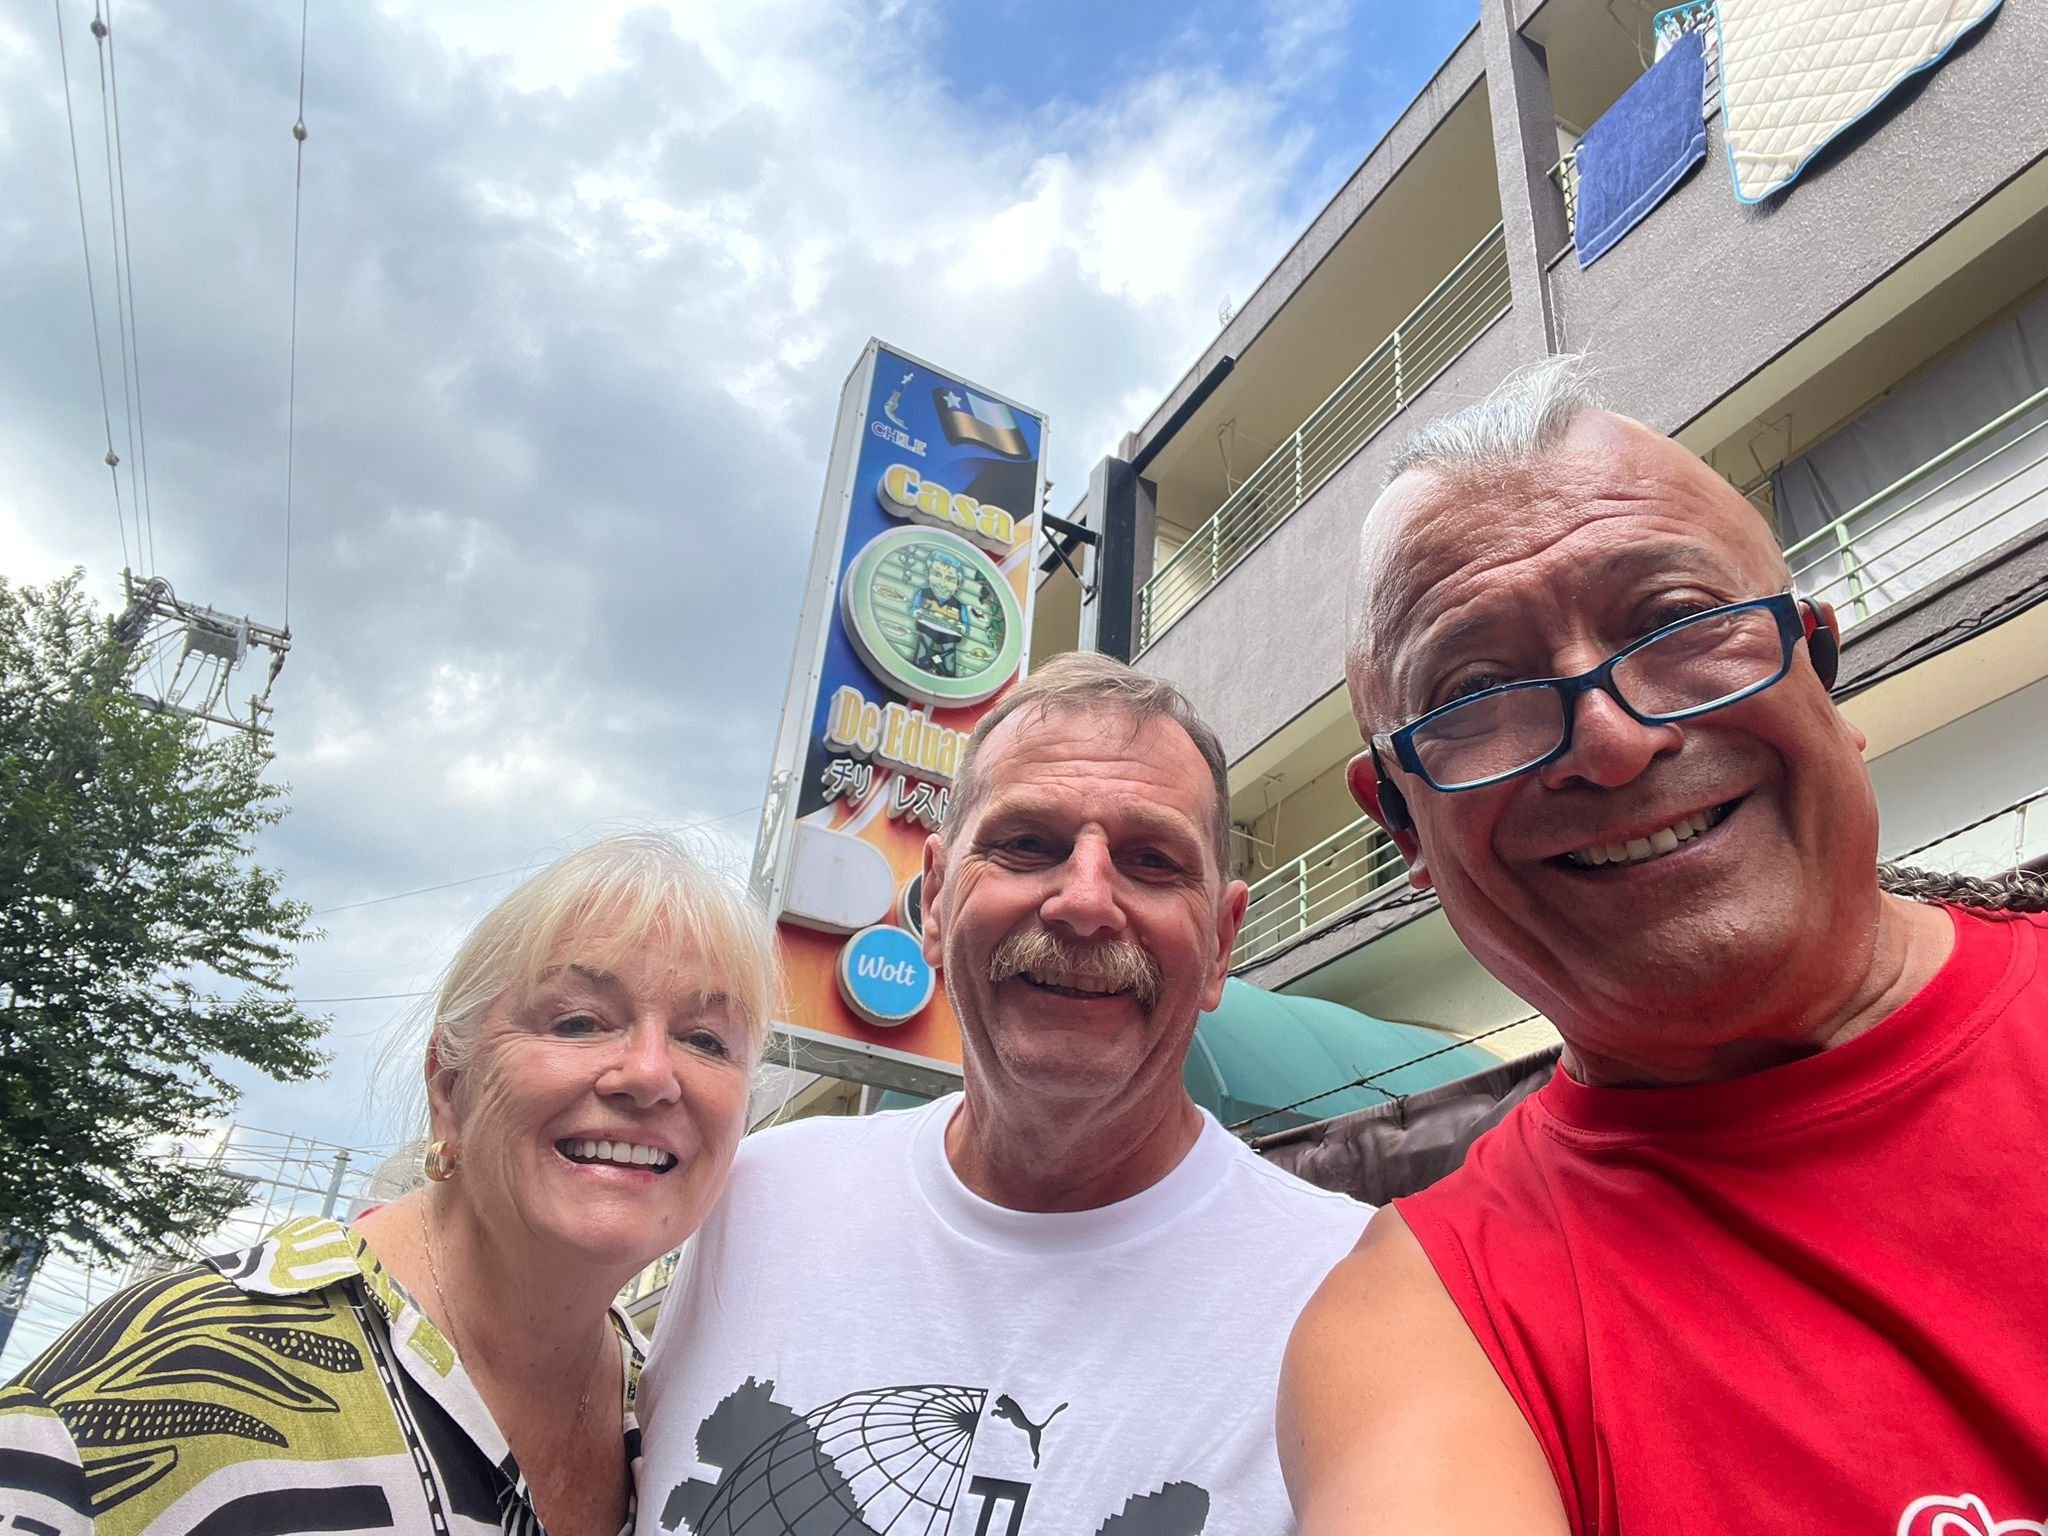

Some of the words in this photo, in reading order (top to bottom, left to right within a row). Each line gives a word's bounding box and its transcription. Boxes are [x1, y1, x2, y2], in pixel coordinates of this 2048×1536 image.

[871, 420, 928, 458] CHILE
[883, 463, 1016, 545] Casa
[833, 686, 880, 752] De
[830, 759, 873, 798] チリ
[857, 954, 917, 986] Wolt
